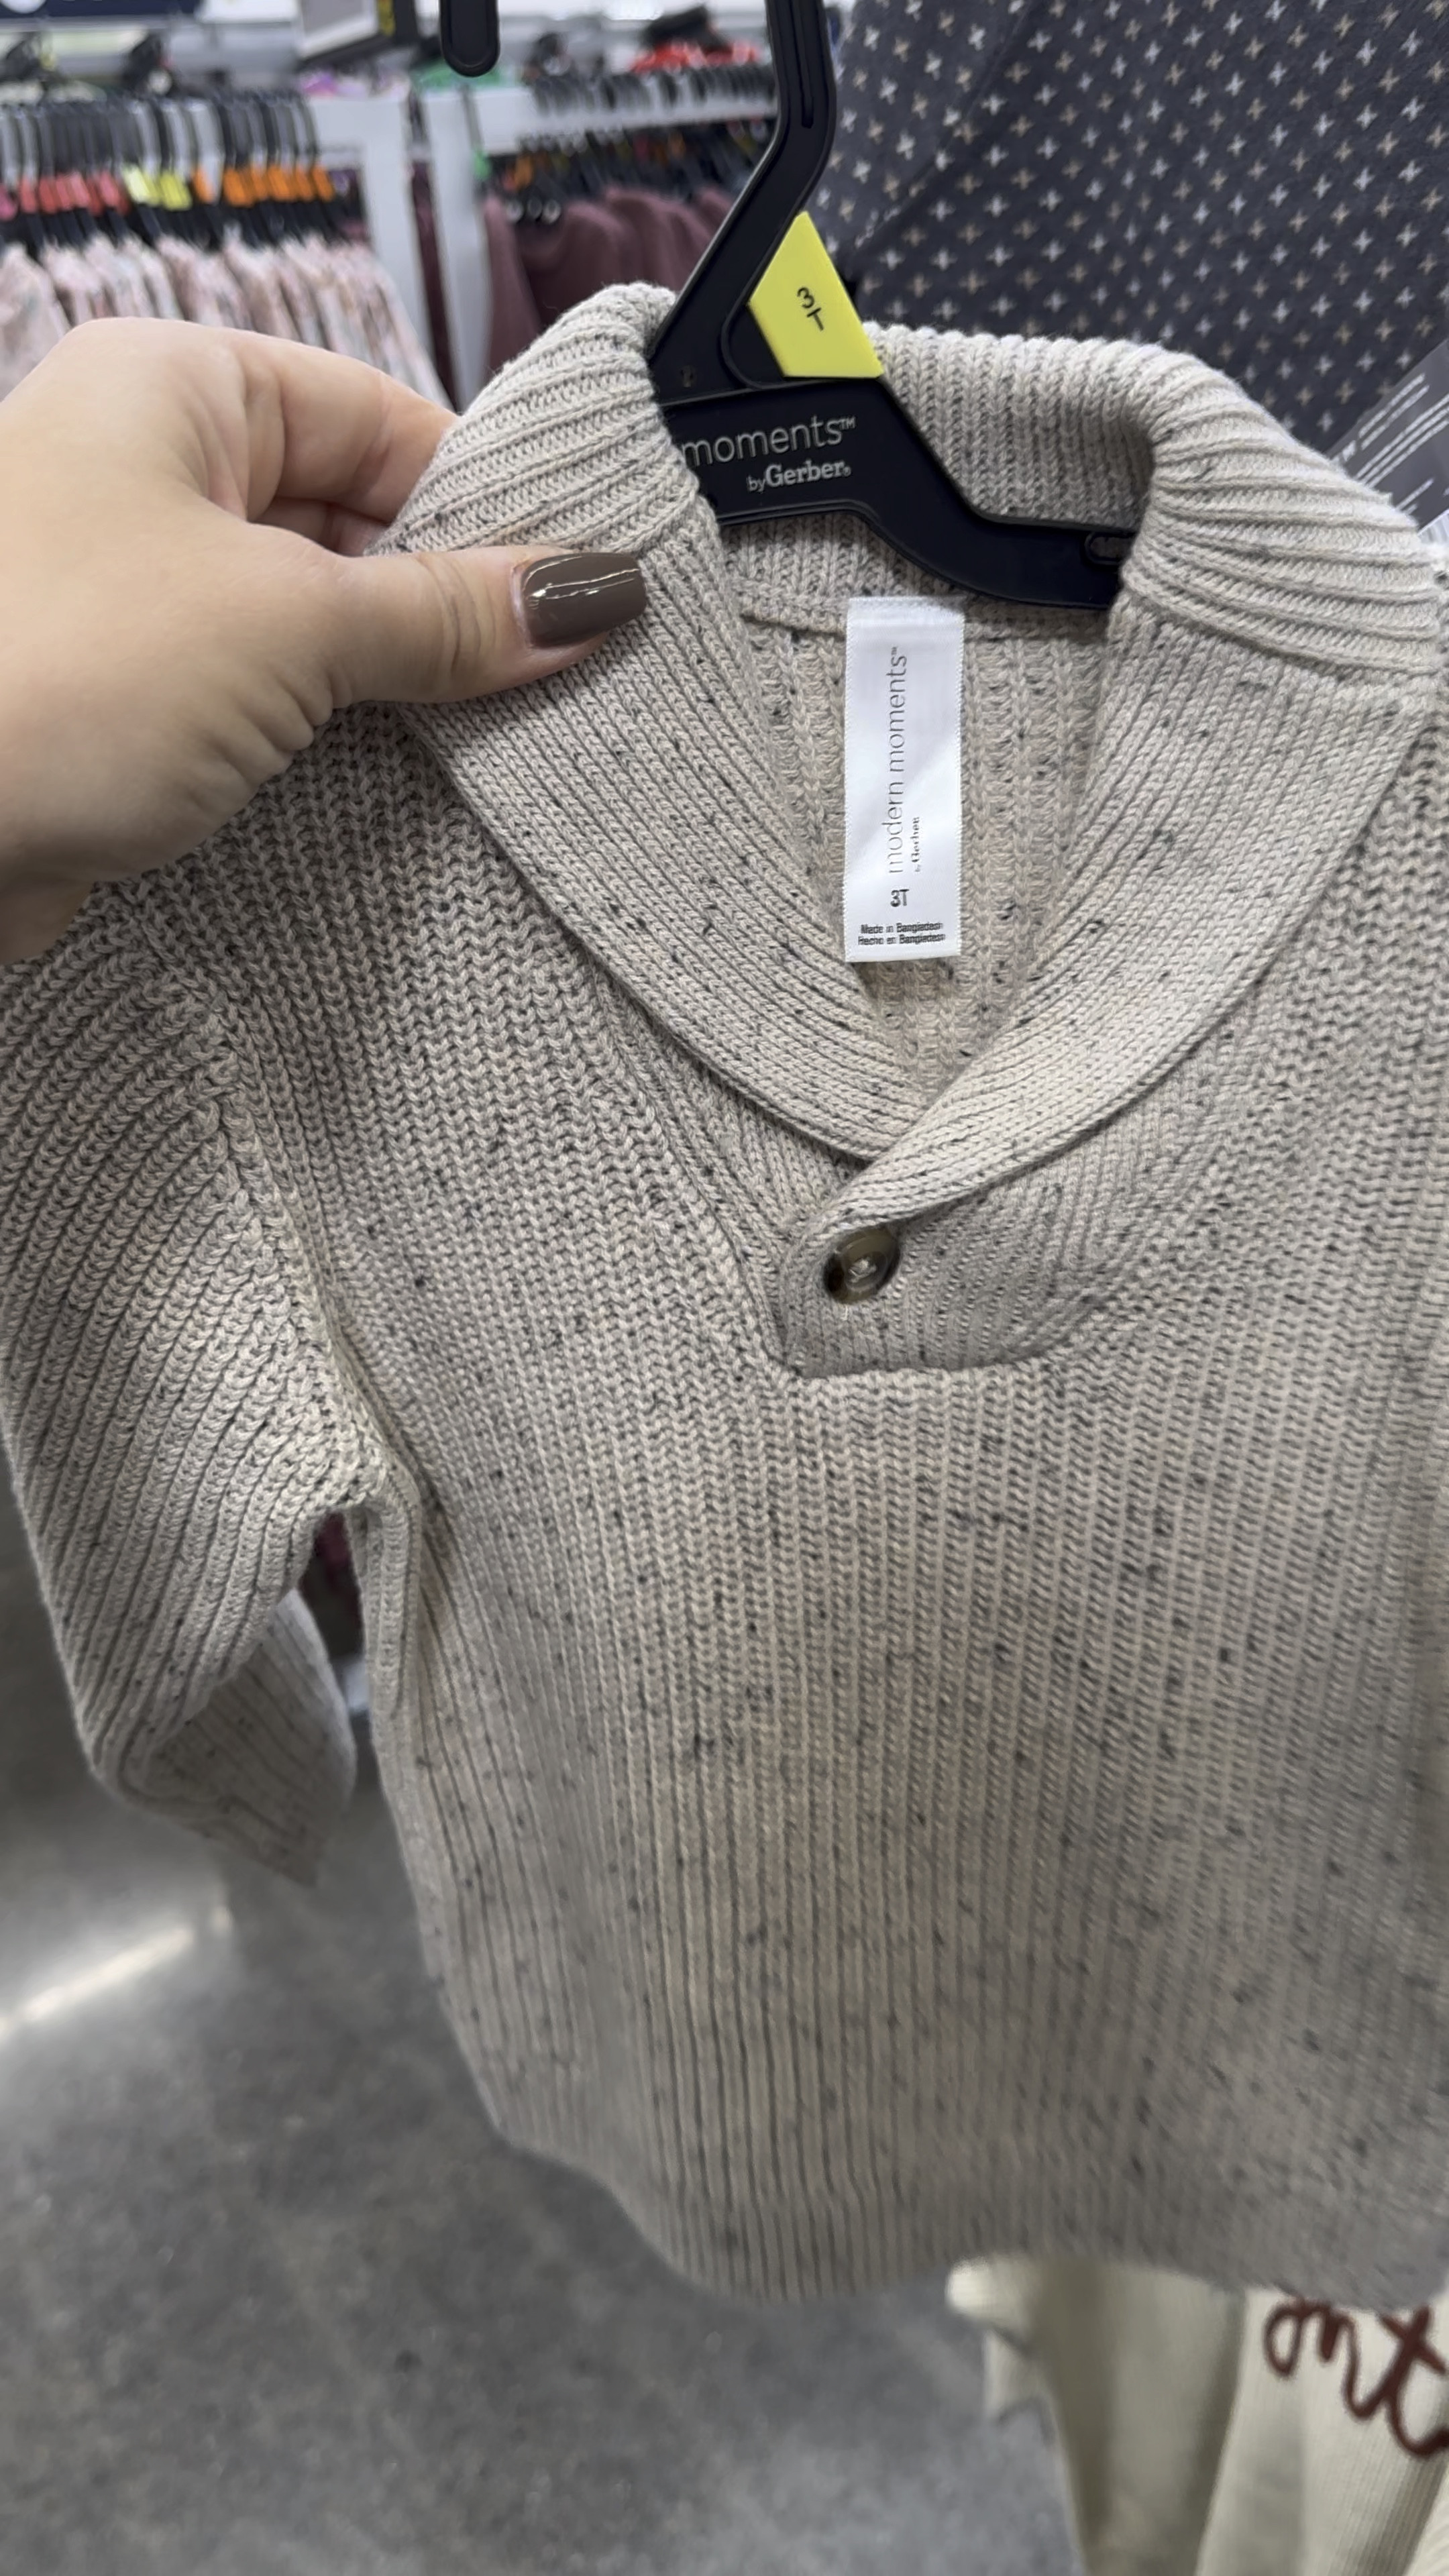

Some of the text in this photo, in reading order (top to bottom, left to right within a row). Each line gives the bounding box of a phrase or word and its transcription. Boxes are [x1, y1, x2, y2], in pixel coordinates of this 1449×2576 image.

[797, 286, 824, 331] 3T
[746, 475, 765, 493] by
[881, 781, 904, 873] modern
[890, 888, 910, 908] 3T
[860, 922, 943, 934] Made in Bangladesh
[858, 933, 946, 945] Hecho en Bangladesh
